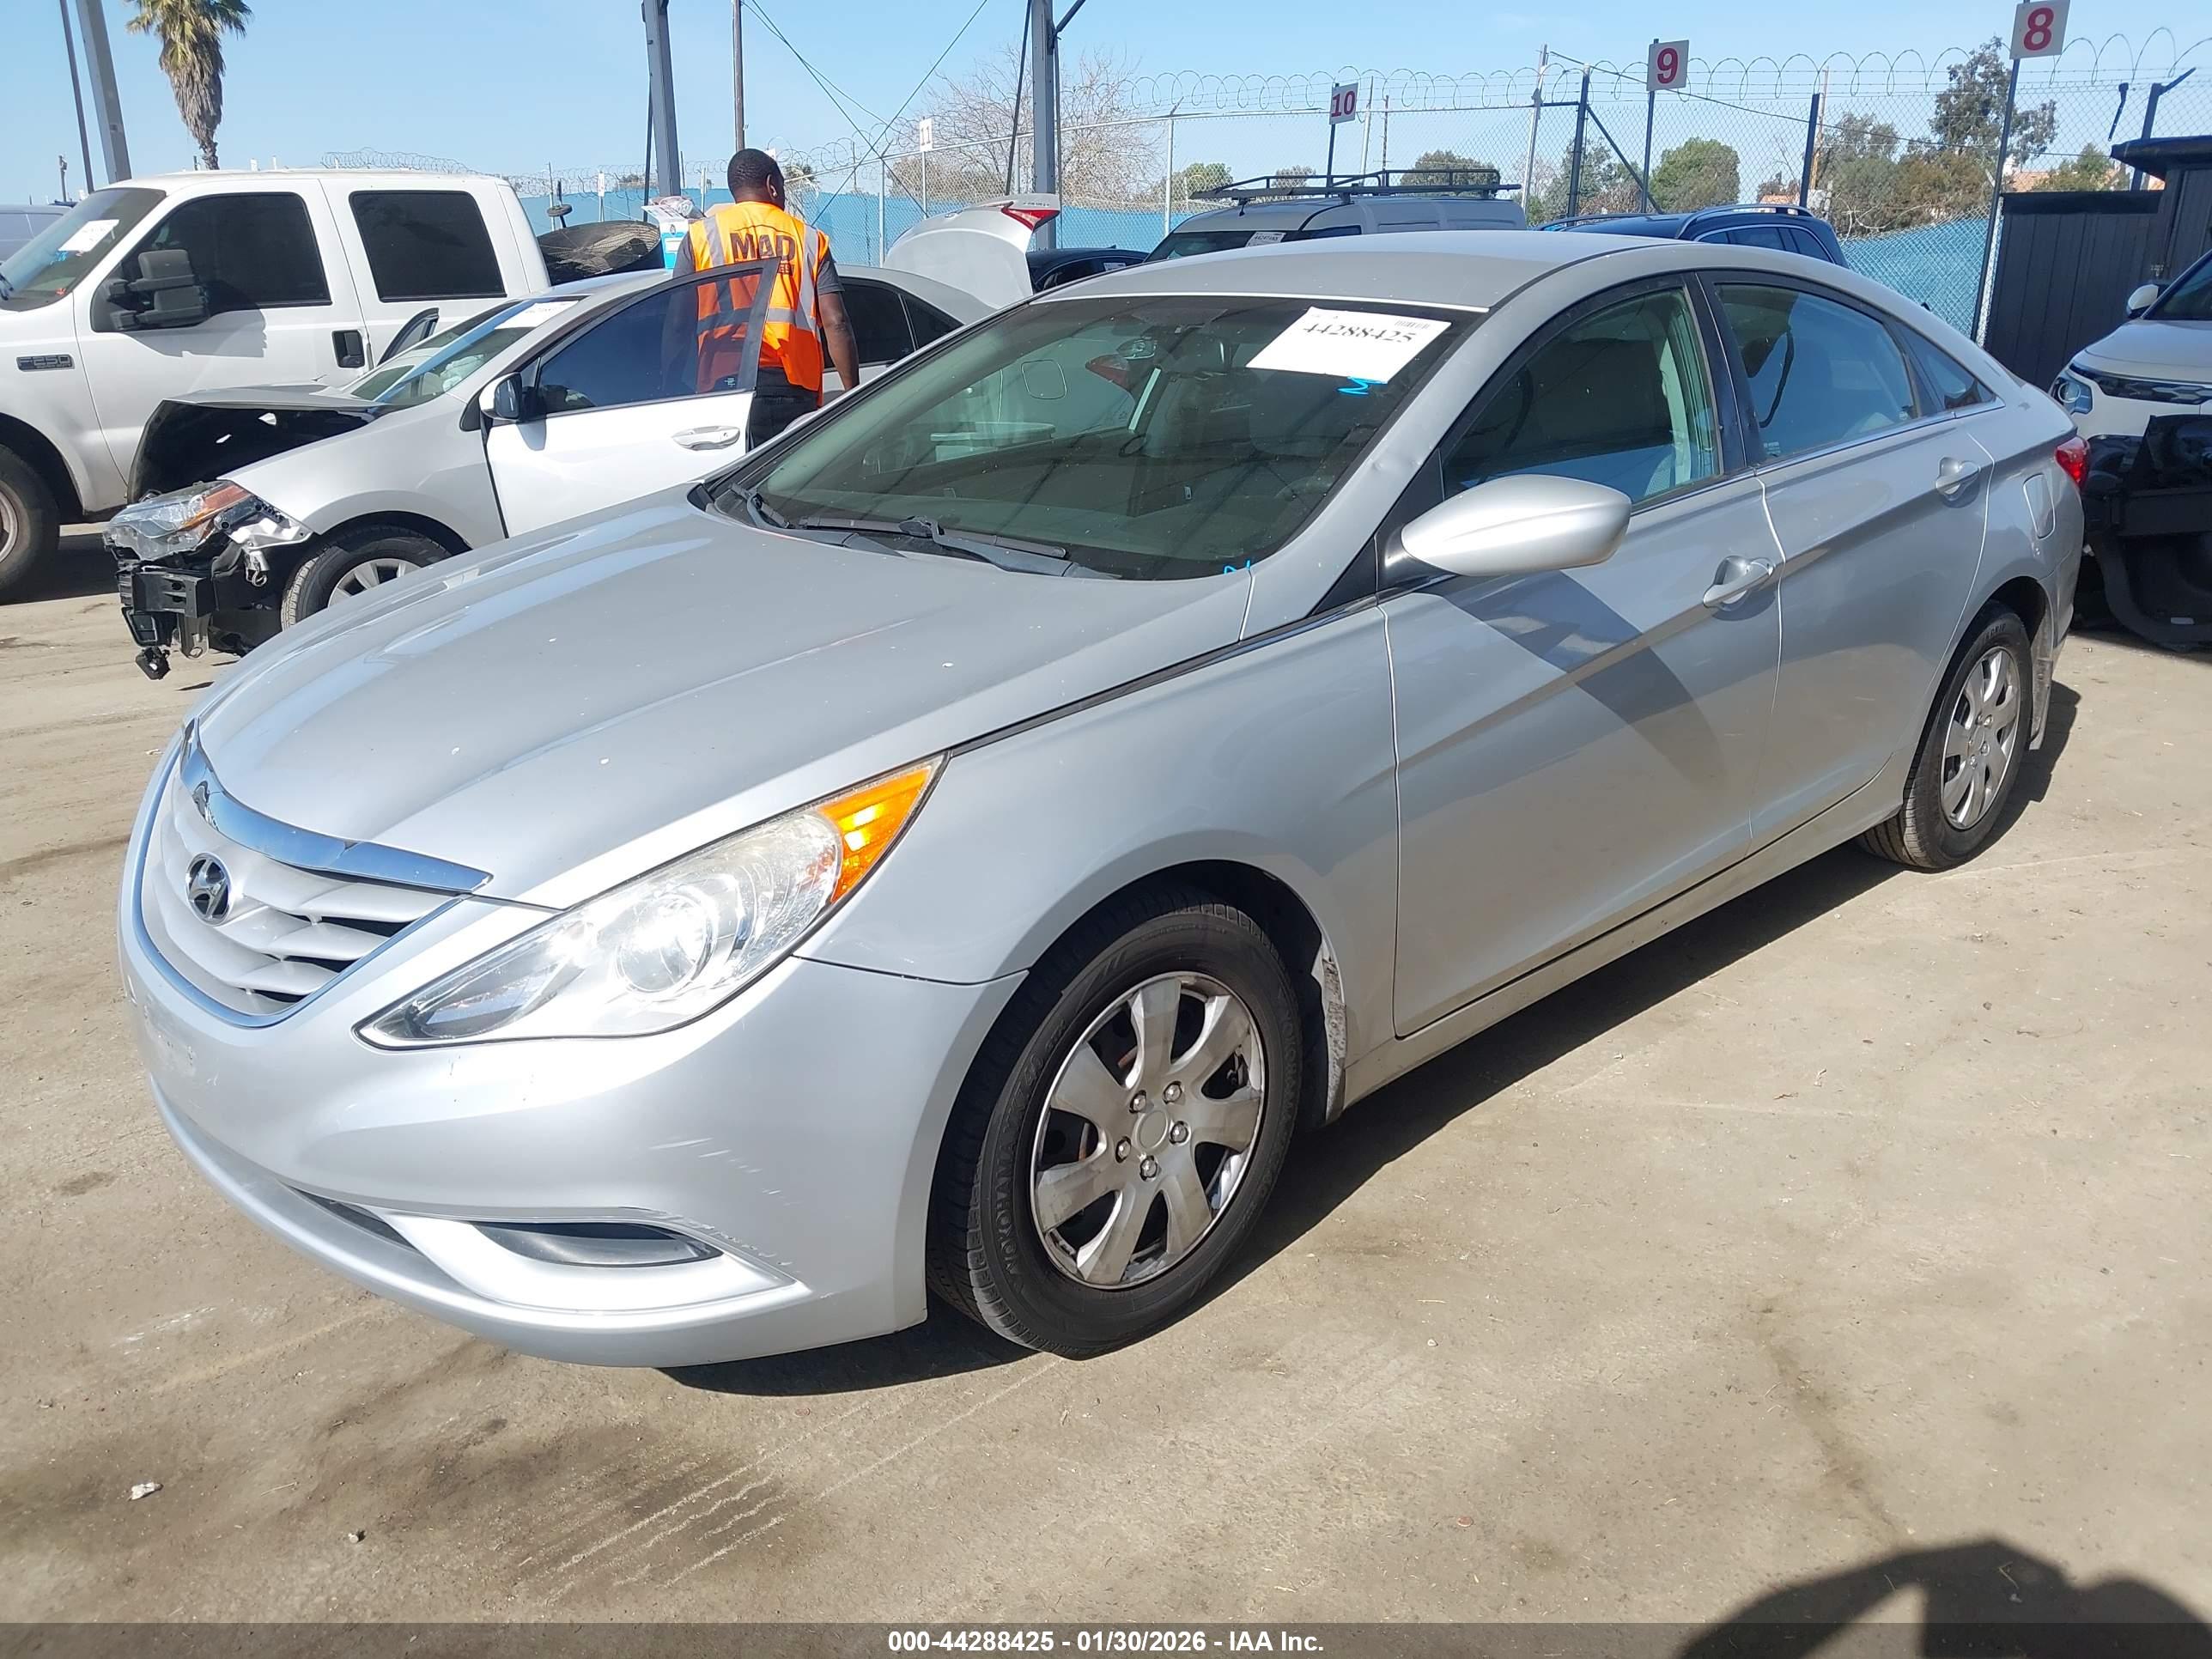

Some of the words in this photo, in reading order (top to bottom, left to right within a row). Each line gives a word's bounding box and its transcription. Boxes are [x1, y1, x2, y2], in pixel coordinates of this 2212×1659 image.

[2023, 7, 2054, 51] 8
[1657, 47, 1678, 84] 9
[1331, 90, 1356, 117] 10
[730, 233, 796, 261] MAD
[1304, 323, 1417, 343] 44288425
